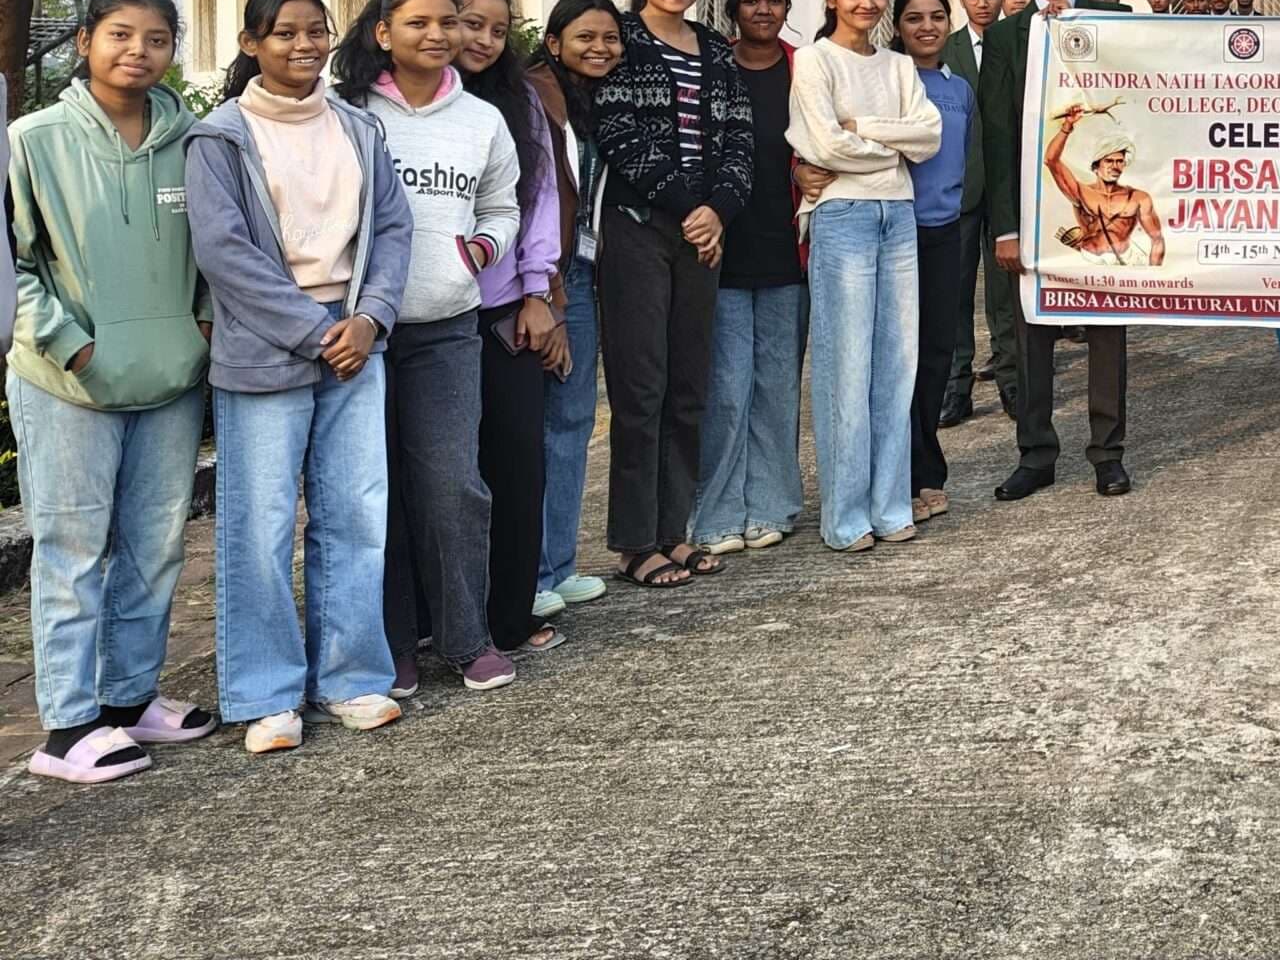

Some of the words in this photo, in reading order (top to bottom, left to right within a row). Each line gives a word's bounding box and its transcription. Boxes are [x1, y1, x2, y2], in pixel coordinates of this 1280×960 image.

[1058, 72, 1153, 89] RABINDRA
[1156, 73, 1206, 90] NATH
[1147, 96, 1242, 116] COLLEGE,
[1172, 159, 1280, 191] BIRSA
[1203, 243, 1230, 259] 14th
[1083, 275, 1116, 287] 11:30
[1118, 279, 1138, 288] am
[1141, 277, 1195, 289] onwards
[1045, 291, 1099, 308] BIRSA
[1101, 295, 1247, 313] AGRICULTURAL
